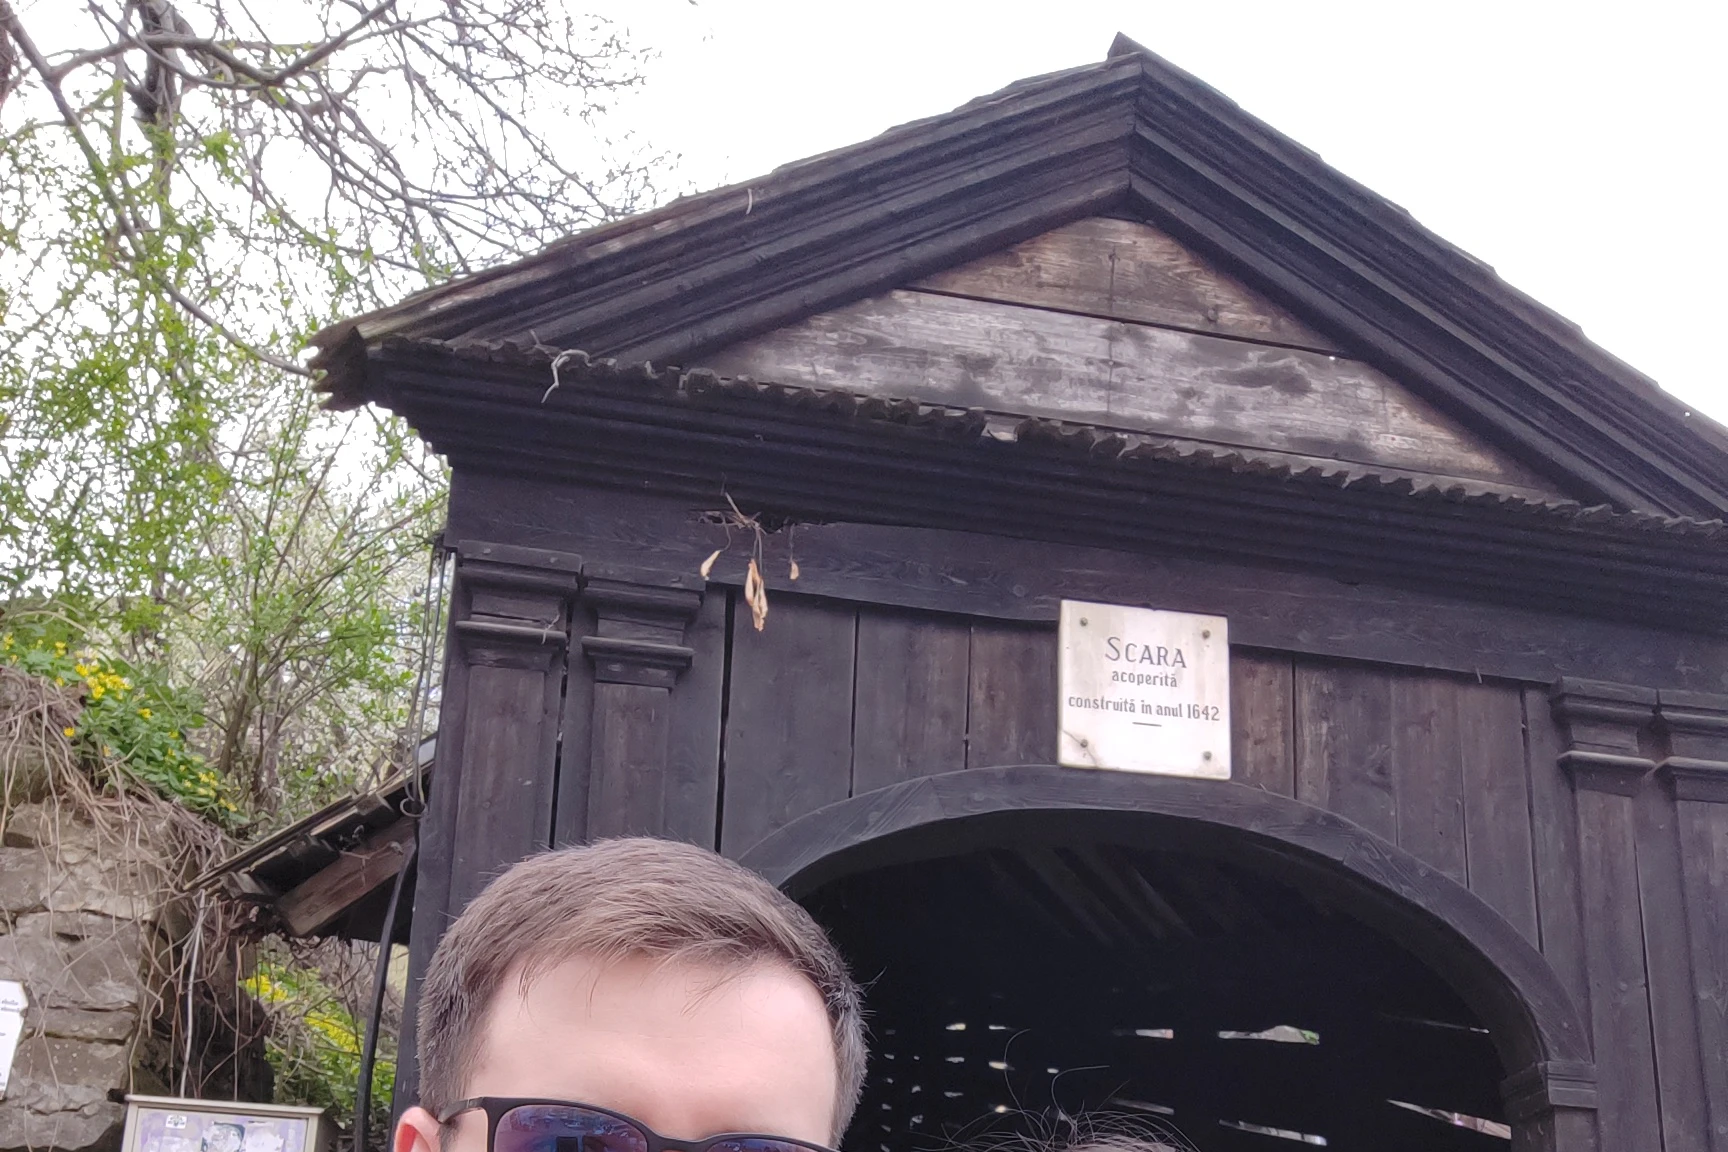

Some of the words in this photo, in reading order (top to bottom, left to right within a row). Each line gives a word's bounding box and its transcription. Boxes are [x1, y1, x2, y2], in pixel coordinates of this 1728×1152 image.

[1105, 636, 1187, 669] SCARA
[1112, 670, 1178, 688] acoperită
[1068, 695, 1136, 713] construită
[1141, 700, 1152, 715] în
[1156, 703, 1183, 718] anul
[1187, 704, 1220, 722] 1642
